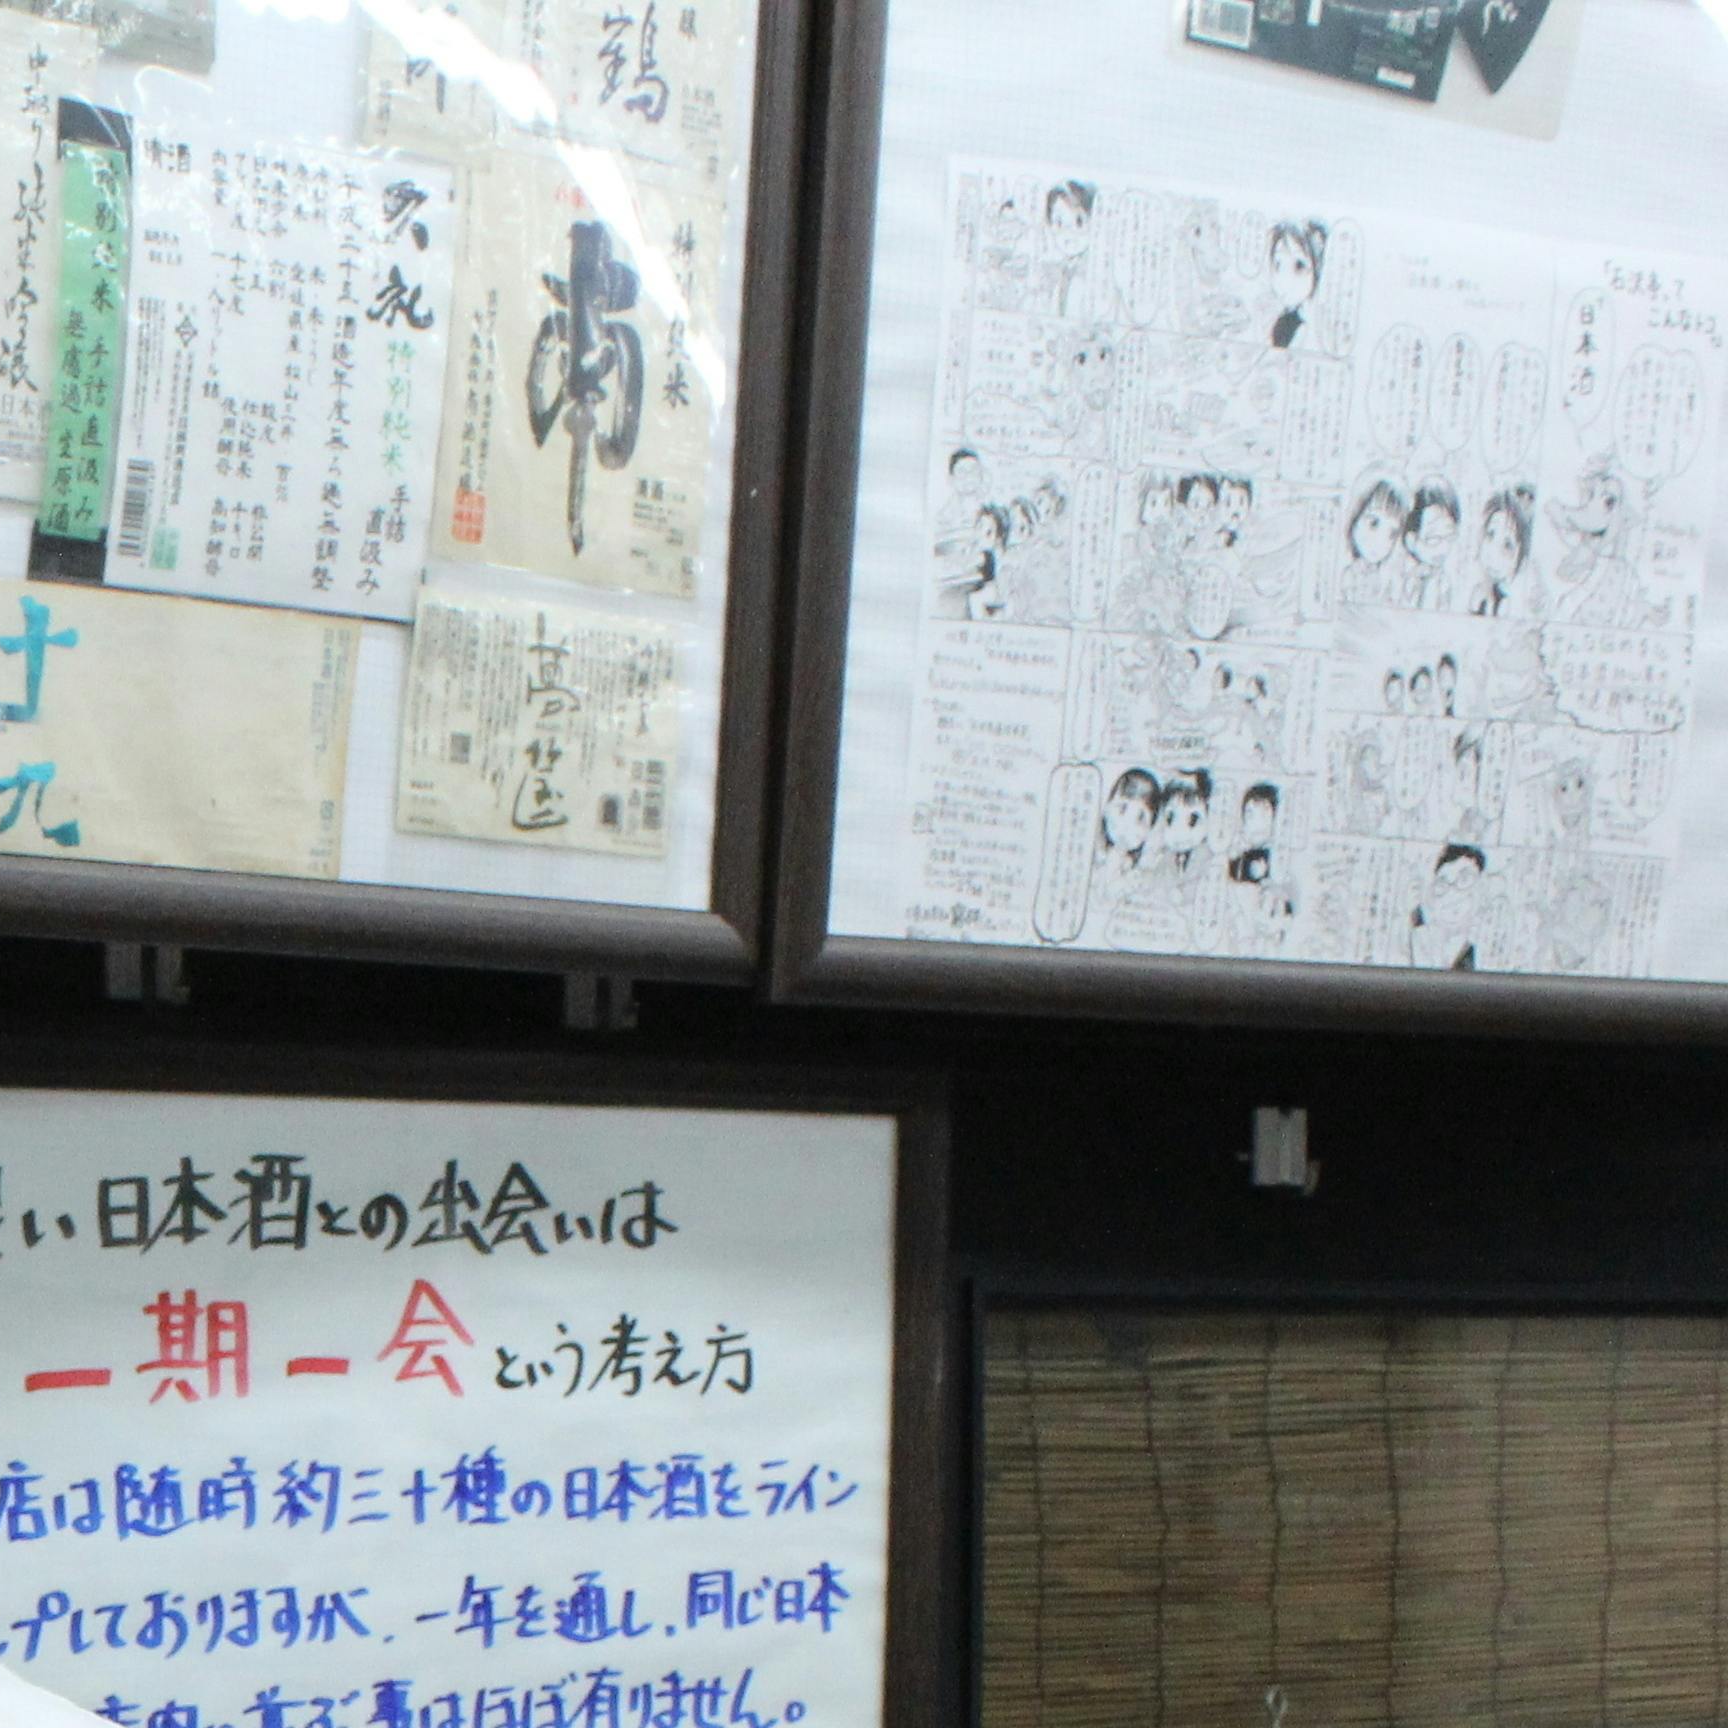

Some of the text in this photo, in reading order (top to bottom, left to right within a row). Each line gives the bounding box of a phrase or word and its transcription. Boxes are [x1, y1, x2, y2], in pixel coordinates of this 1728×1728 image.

[22, 1276, 754, 1405] 一期一会という考え方
